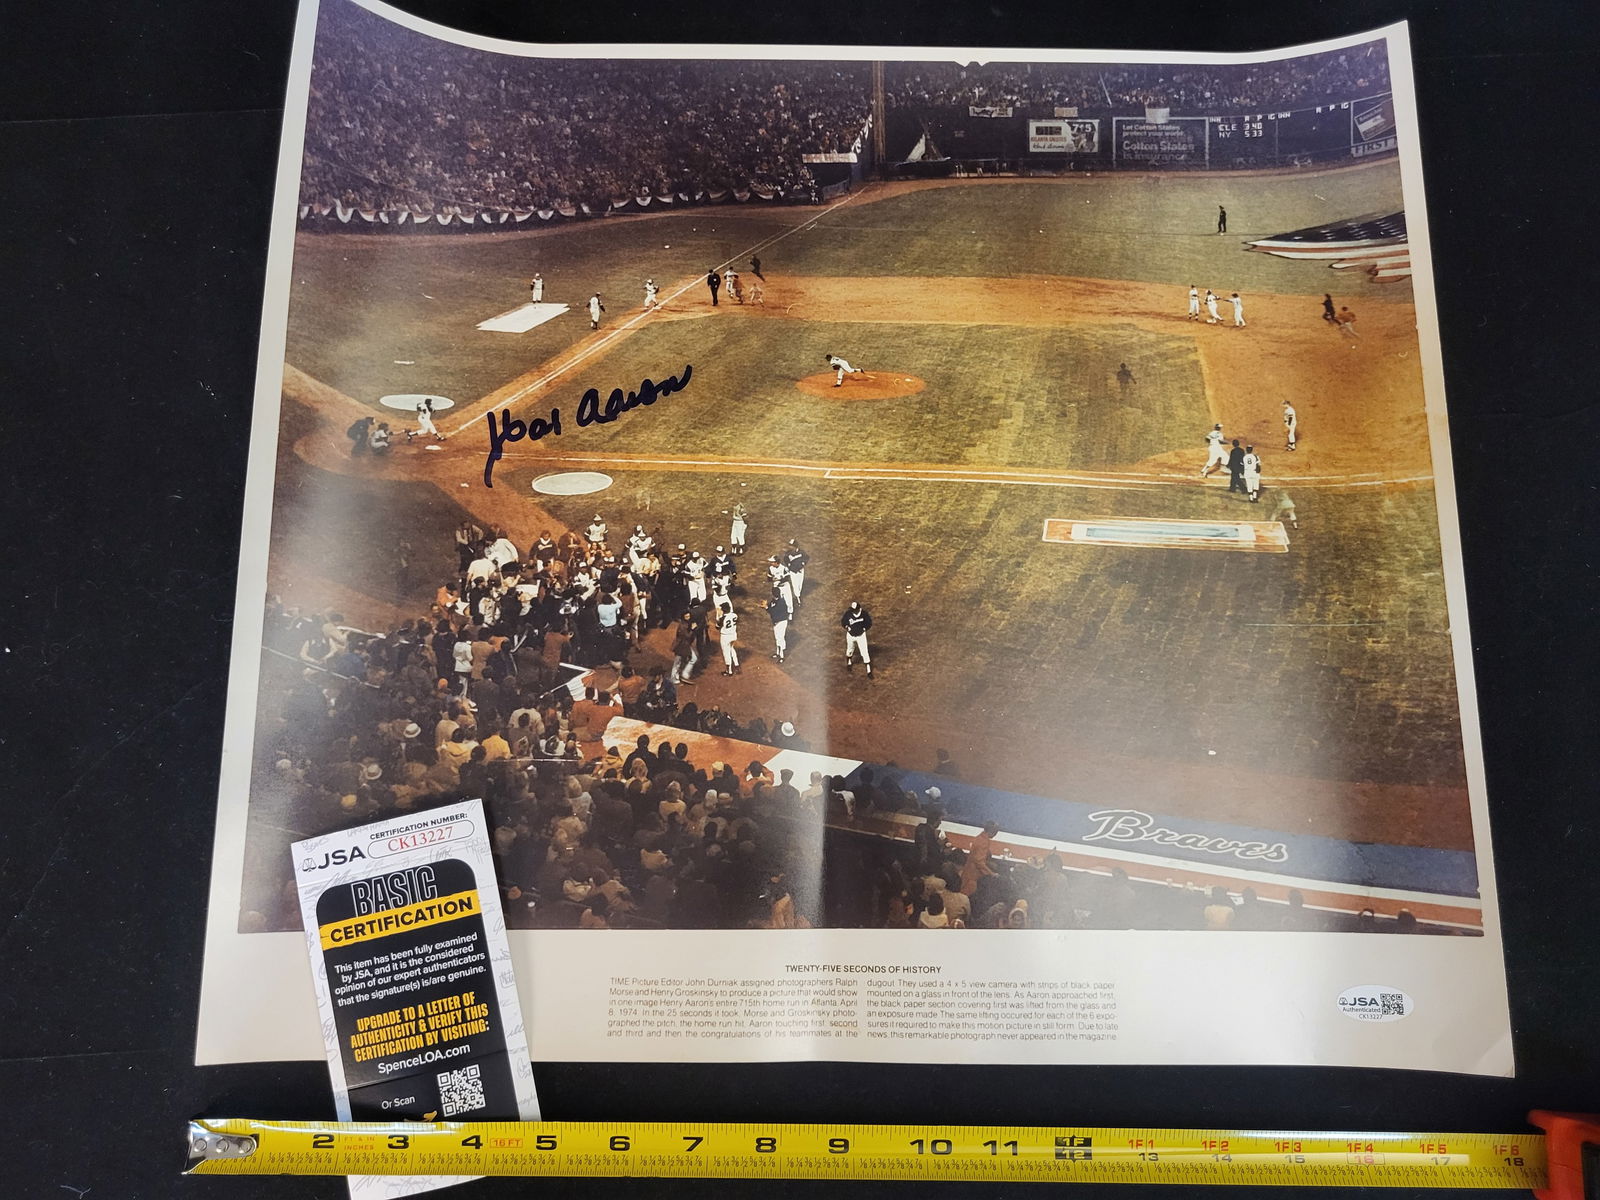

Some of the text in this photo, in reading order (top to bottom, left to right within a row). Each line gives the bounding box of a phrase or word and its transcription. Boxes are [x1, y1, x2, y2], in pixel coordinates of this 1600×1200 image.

[1072, 124, 1092, 132] 715
[1123, 141, 1194, 150] Cotton States
[1353, 140, 1388, 155] FIRST
[370, 812, 468, 840] CERTIFICATION NUMBER:
[388, 826, 454, 852] CK13227
[1082, 810, 1289, 862] Braves
[317, 846, 366, 870] JSA
[350, 865, 438, 917] BASIC
[330, 896, 473, 943] CERTIFICATION
[334, 931, 478, 974] This item has been fully examined
[341, 944, 474, 987] by JSA, and it is the considered
[785, 965, 842, 973] TWENTY-FIVE
[843, 965, 887, 973] SECONDS
[902, 966, 942, 974] HISTORY
[334, 952, 486, 996] opinion of our expert authenticators
[337, 966, 487, 1007] that the signature(s) is/are genuine.
[611, 977, 858, 988] TIME Picture Editor John Durniak assigned photographers Ralph
[609, 988, 633, 996] Morse
[634, 988, 649, 996] and
[650, 988, 674, 997] Henry
[675, 988, 718, 997] Groskinsky
[719, 989, 727, 997] to
[729, 989, 762, 998] produce
[769, 989, 796, 998] picture
[634, 999, 658, 1008] image
[659, 999, 682, 1008] Henry
[716, 999, 738, 1007] entire
[739, 999, 761, 1007] 715th
[762, 999, 785, 1007] home
[839, 998, 858, 1007] April
[1348, 997, 1379, 1006] JSA
[357, 991, 476, 1032] UPGRADE TO A LETTER OF
[350, 1003, 489, 1049] AUTHENTICITY & VERIFY THIS
[354, 1020, 490, 1063] CERTIFICATION BY VISITING:
[377, 1044, 471, 1075] SpenceLOA.com
[381, 1095, 416, 1110] Or Scan
[312, 1134, 1018, 1156] 2 3 4 16 FT 5 6 7 8 9 10 11
[1062, 1137, 1085, 1146] 1F
[1062, 1150, 1085, 1159] 12
[1139, 1153, 1159, 1161] 13
[1212, 1154, 1232, 1163] 14
[1284, 1155, 1305, 1163] 15
[1354, 1155, 1374, 1164] 16
[1431, 1156, 1451, 1166] 17
[1504, 1157, 1525, 1166] 18
